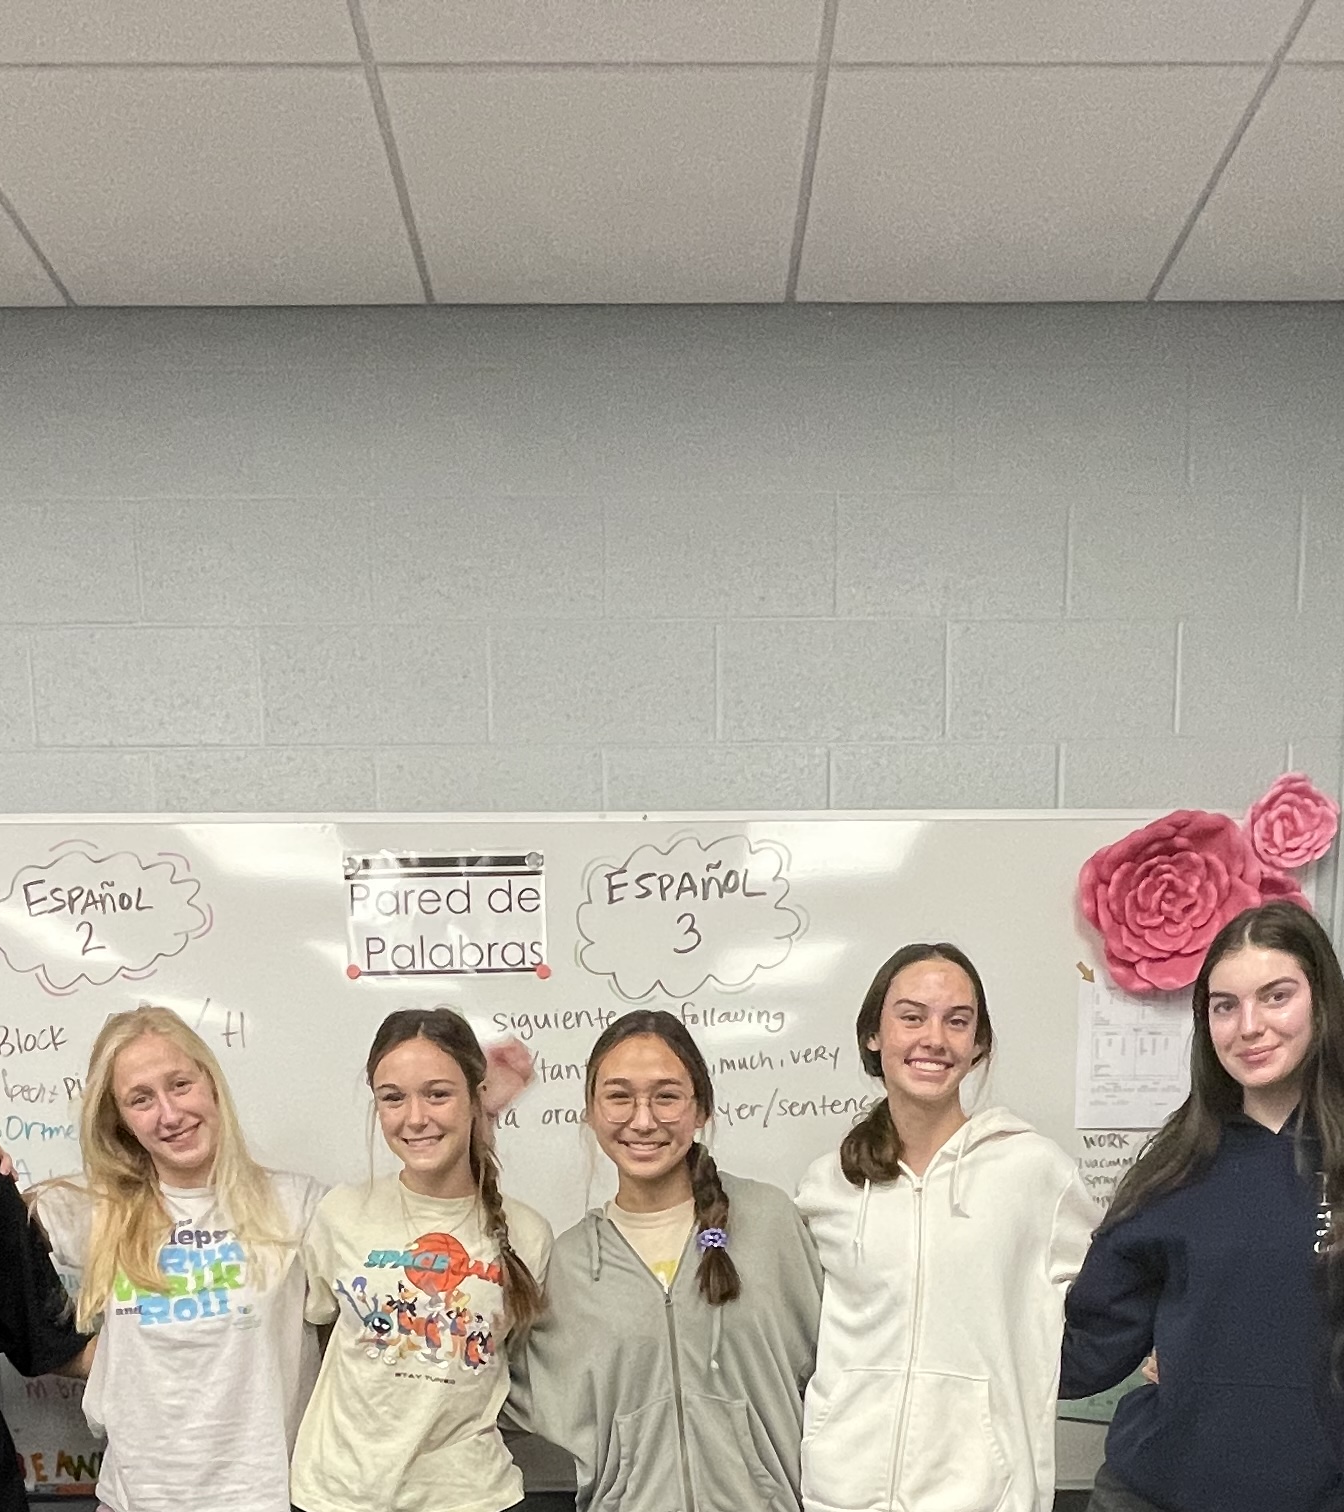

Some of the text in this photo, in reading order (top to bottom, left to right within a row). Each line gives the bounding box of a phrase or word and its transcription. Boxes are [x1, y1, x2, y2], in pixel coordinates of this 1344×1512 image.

[350, 879, 542, 917] Pared de
[75, 921, 106, 956] 2
[673, 912, 703, 955] 3
[365, 935, 544, 970] Palabras
[363, 1249, 451, 1274] SPACE
